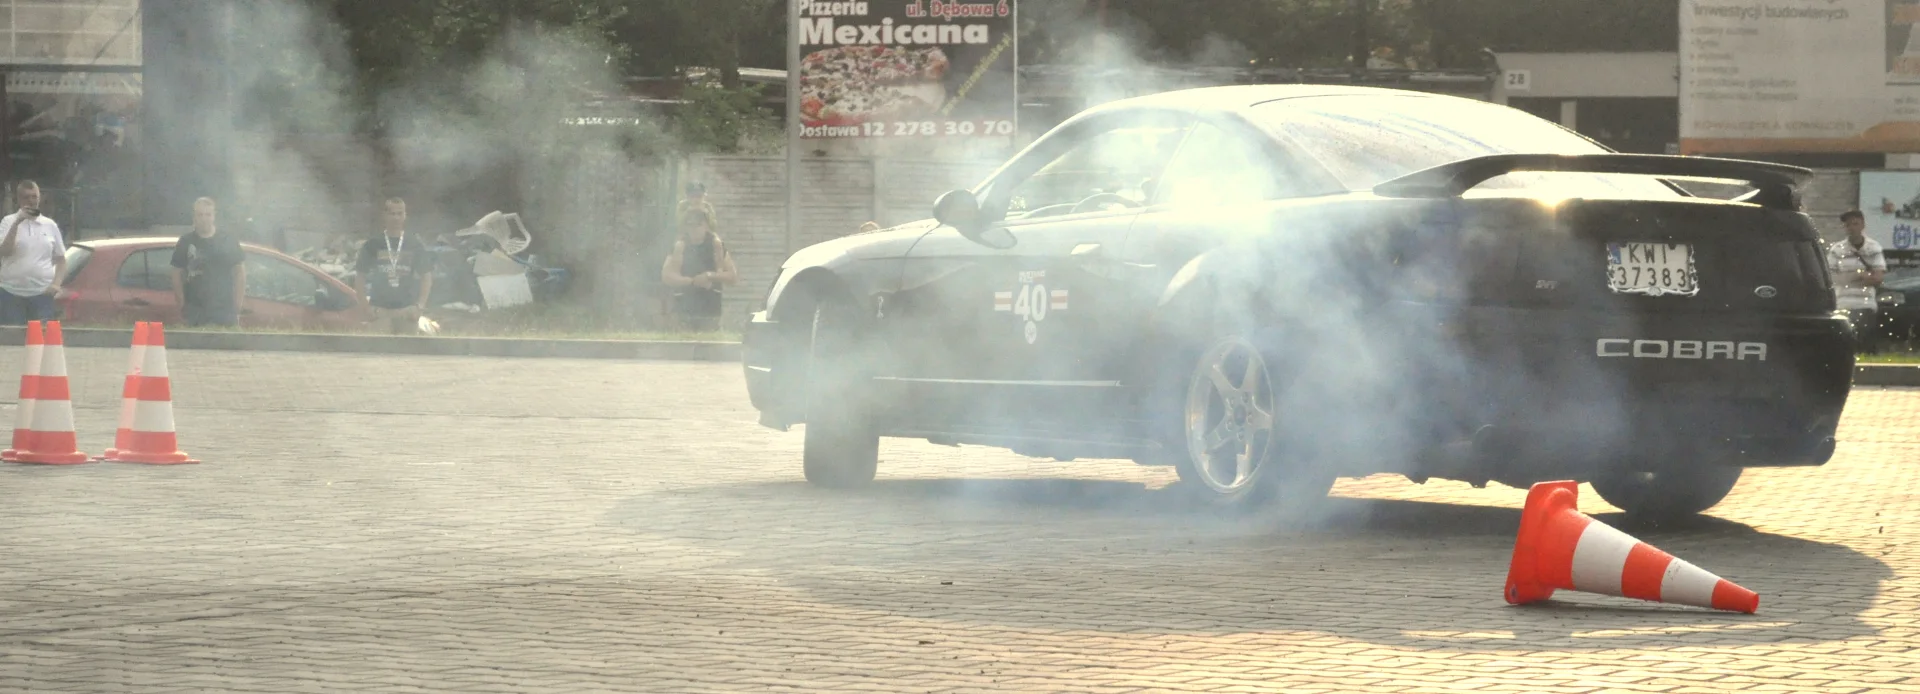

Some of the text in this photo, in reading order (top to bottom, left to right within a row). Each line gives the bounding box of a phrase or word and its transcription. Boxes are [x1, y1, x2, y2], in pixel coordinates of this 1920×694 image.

[799, 0, 868, 15] Pizzeria
[906, 0, 1009, 21] ul. Dębowa 6
[799, 17, 988, 44] Mexicana
[1508, 73, 1525, 85] 28
[863, 121, 885, 136] 12
[894, 121, 937, 136] 278
[944, 120, 975, 135] 30
[983, 120, 1013, 135] 70
[1628, 243, 1668, 264] KWI
[1617, 266, 1687, 288] 37383
[1014, 284, 1047, 321] 40
[1596, 338, 1768, 361] COBRA
